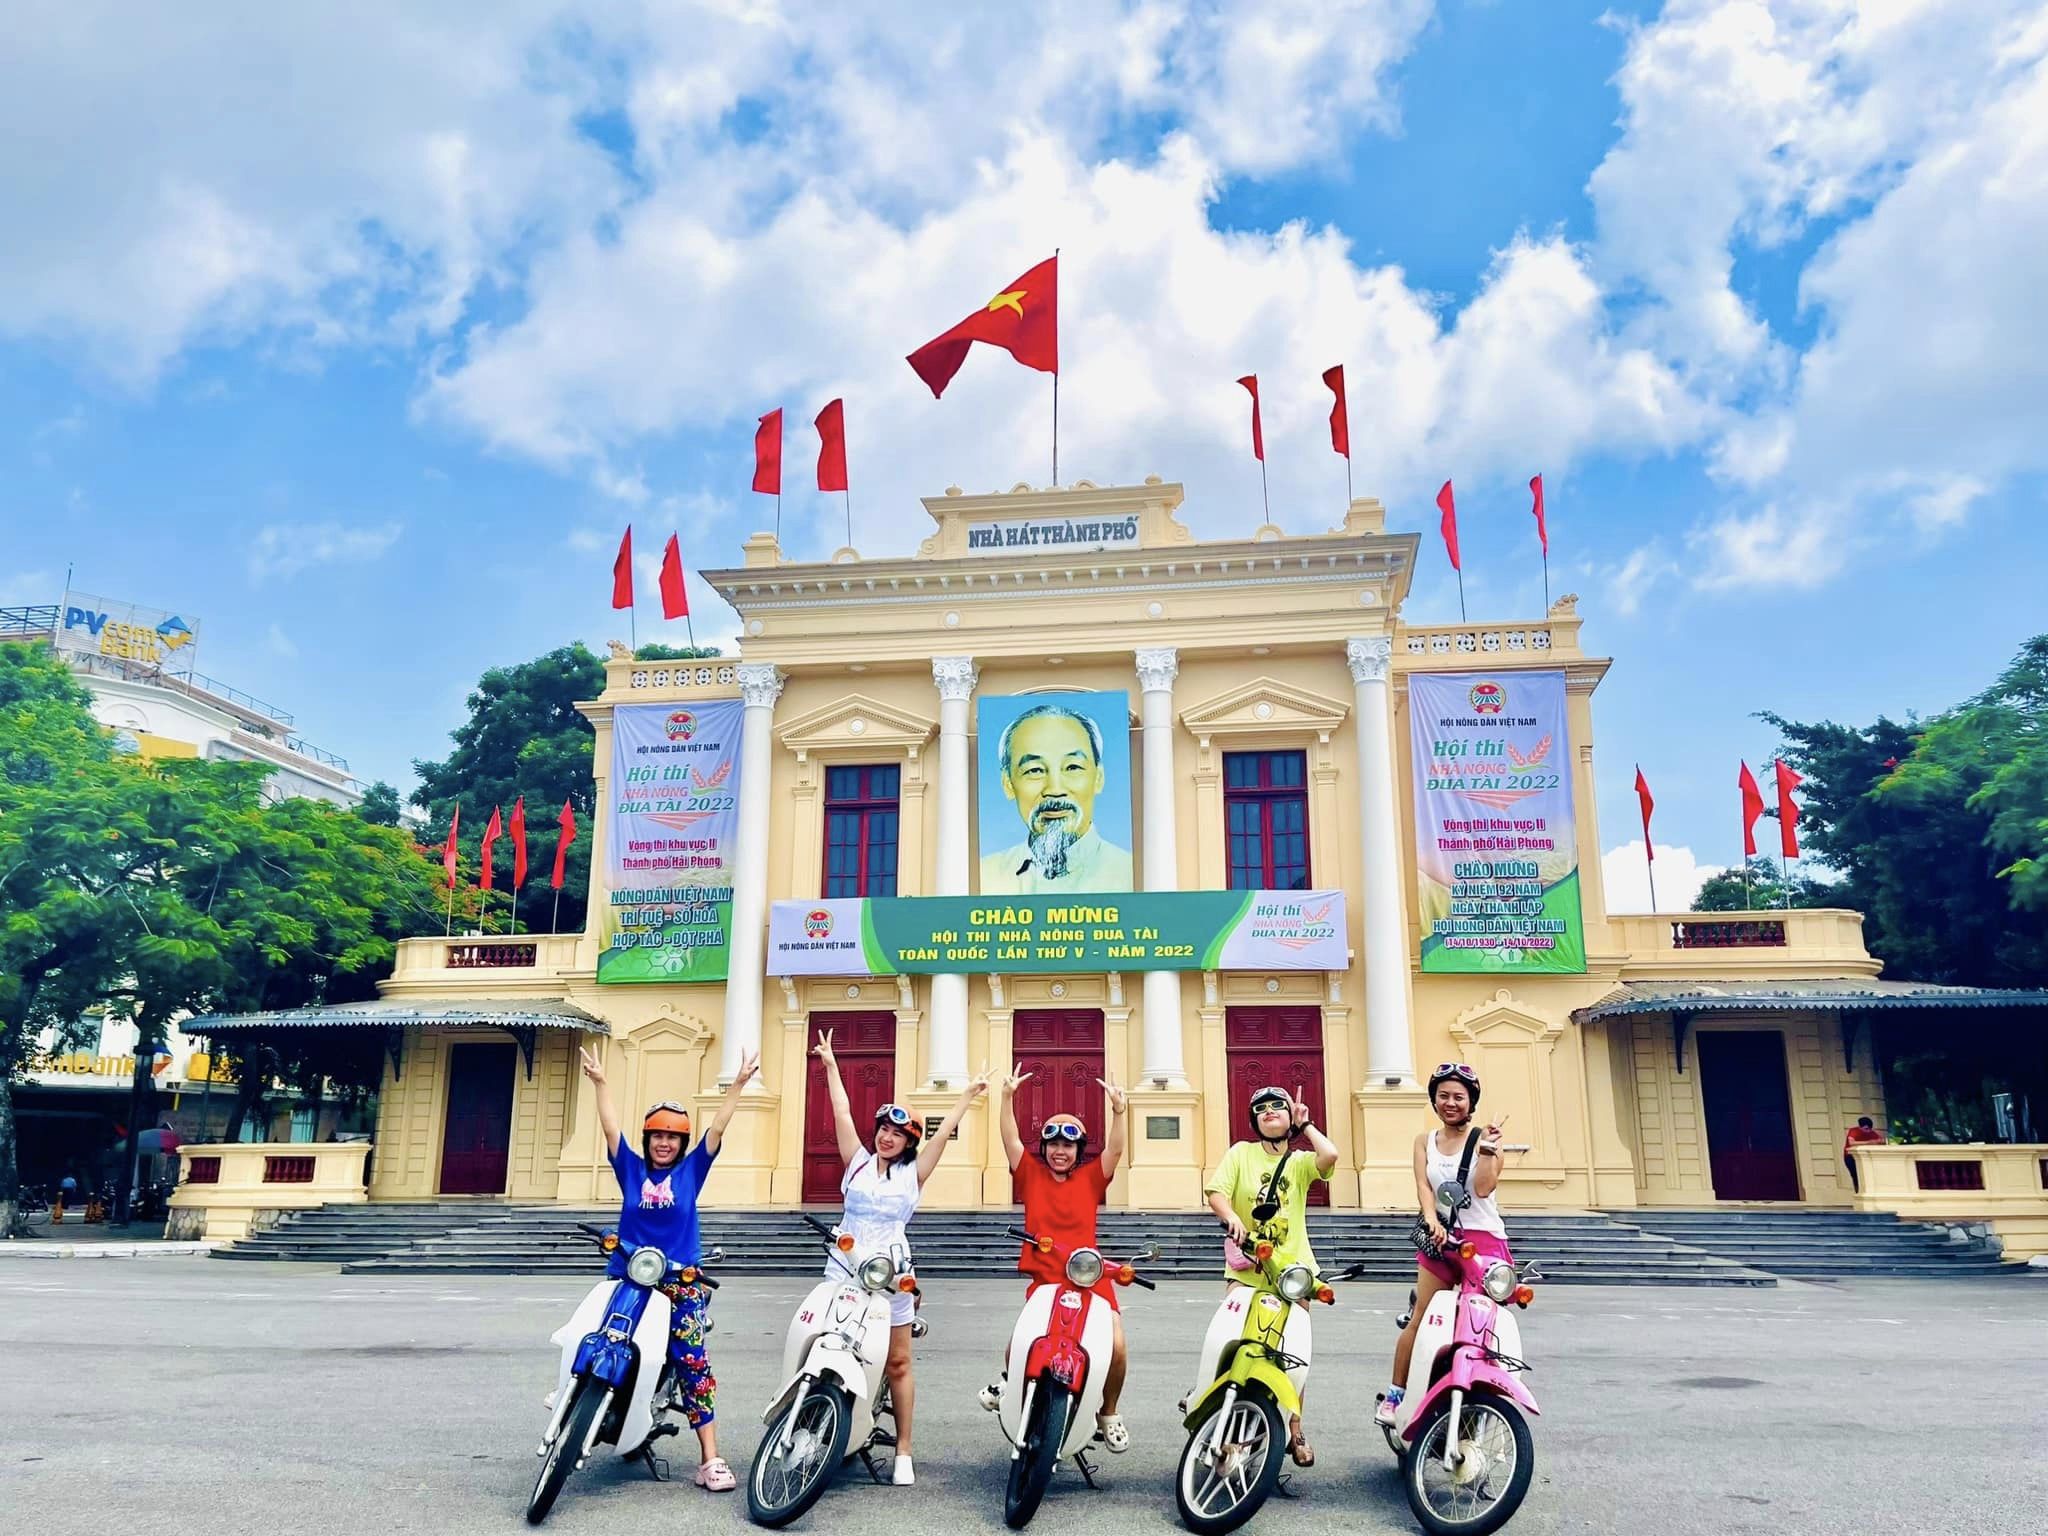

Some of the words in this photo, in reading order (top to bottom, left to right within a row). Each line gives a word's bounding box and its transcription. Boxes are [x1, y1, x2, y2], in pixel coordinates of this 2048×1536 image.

[969, 524, 1003, 548] NHÀ
[1006, 522, 1040, 546] HÁT
[1041, 520, 1100, 544] THÀNH
[1102, 516, 1139, 541] PHỐ
[1440, 718, 1454, 728] HỘI
[1456, 718, 1478, 727] NÔNG
[1480, 718, 1497, 727] DÂN
[1499, 717, 1515, 728] VIỆT
[1517, 717, 1537, 726] NAM
[637, 745, 648, 754] HỘI
[650, 745, 670, 753] NÔNG
[671, 744, 686, 753] DÂN
[688, 744, 702, 754] VIỆT
[703, 743, 720, 752] NAM
[1429, 761, 1460, 776] NHÀ
[1464, 761, 1507, 774] NÔNG
[1426, 778, 1465, 790] ĐUA
[1471, 775, 1501, 790] TÀI
[1506, 775, 1560, 789] 2022
[623, 785, 648, 799] NHÀ
[651, 785, 688, 798] NÔNG
[618, 801, 651, 814] ĐUA
[656, 798, 682, 812] TÀI
[687, 797, 734, 811] 2022
[1443, 819, 1471, 832] Vòng
[1472, 818, 1487, 830] thi
[1490, 818, 1511, 830] khu
[1513, 819, 1534, 832] vực
[629, 840, 651, 852] Vòng
[654, 839, 666, 851] thi
[668, 839, 687, 850] khu
[689, 839, 706, 852] vực
[1438, 837, 1470, 850] Thành
[1473, 835, 1495, 850] phố
[1496, 836, 1514, 849] Hải
[1517, 836, 1553, 850] Phòng
[623, 857, 650, 869] Thành
[652, 855, 672, 869] phố
[672, 855, 688, 868] Hải
[691, 856, 721, 870] Phòng
[1454, 860, 1491, 878] CHÀO
[1494, 859, 1537, 878] MỪNG
[611, 887, 642, 904] NÔNG
[645, 886, 670, 903] DÂN
[673, 884, 700, 905] VIỆT
[702, 887, 730, 902] NAM
[1468, 881, 1497, 898] NIỆM
[1499, 883, 1513, 896] 92
[969, 905, 1034, 925] CHÀO
[1046, 904, 1119, 925] MỪNG
[1452, 899, 1481, 914] NGÀY
[1484, 899, 1519, 914] THÀNH
[1521, 898, 1543, 916] LẬP
[620, 908, 638, 925] TRÍ
[640, 907, 663, 927] TUỆ
[673, 905, 693, 923] SỐ
[694, 906, 717, 923] HÓA
[1252, 929, 1276, 938] ĐUA
[1280, 928, 1298, 938] TÀI
[1301, 928, 1335, 938] 2022
[1433, 918, 1452, 934] HỘI
[1453, 918, 1485, 933] NÔNG
[1487, 917, 1511, 933] DÂN
[1512, 917, 1536, 935] VIỆT
[1537, 920, 1565, 933] NAM
[613, 931, 637, 949] HỢP
[640, 929, 661, 946] TÁC
[672, 929, 696, 949] ĐỘT
[698, 928, 723, 945] PHÁ
[931, 930, 958, 945] HỘI
[966, 931, 991, 943] THI
[999, 929, 1032, 943] NHÀ
[1039, 928, 1085, 942] NÔNG
[1093, 928, 1125, 941] ĐUA
[1133, 927, 1160, 941] TÀI
[779, 942, 790, 952] HỘI
[791, 942, 809, 951] NÔNG
[811, 942, 824, 950] DÂN
[826, 941, 839, 951] VIỆT
[898, 947, 938, 960] TOÀN
[946, 945, 989, 960] QUỐC
[1036, 945, 1068, 959] THỨ
[1074, 947, 1084, 958] V
[1107, 945, 1146, 958] NĂM
[1154, 945, 1194, 957] 2022
[800, 1310, 814, 1324] 31
[1428, 1314, 1443, 1326] 15
